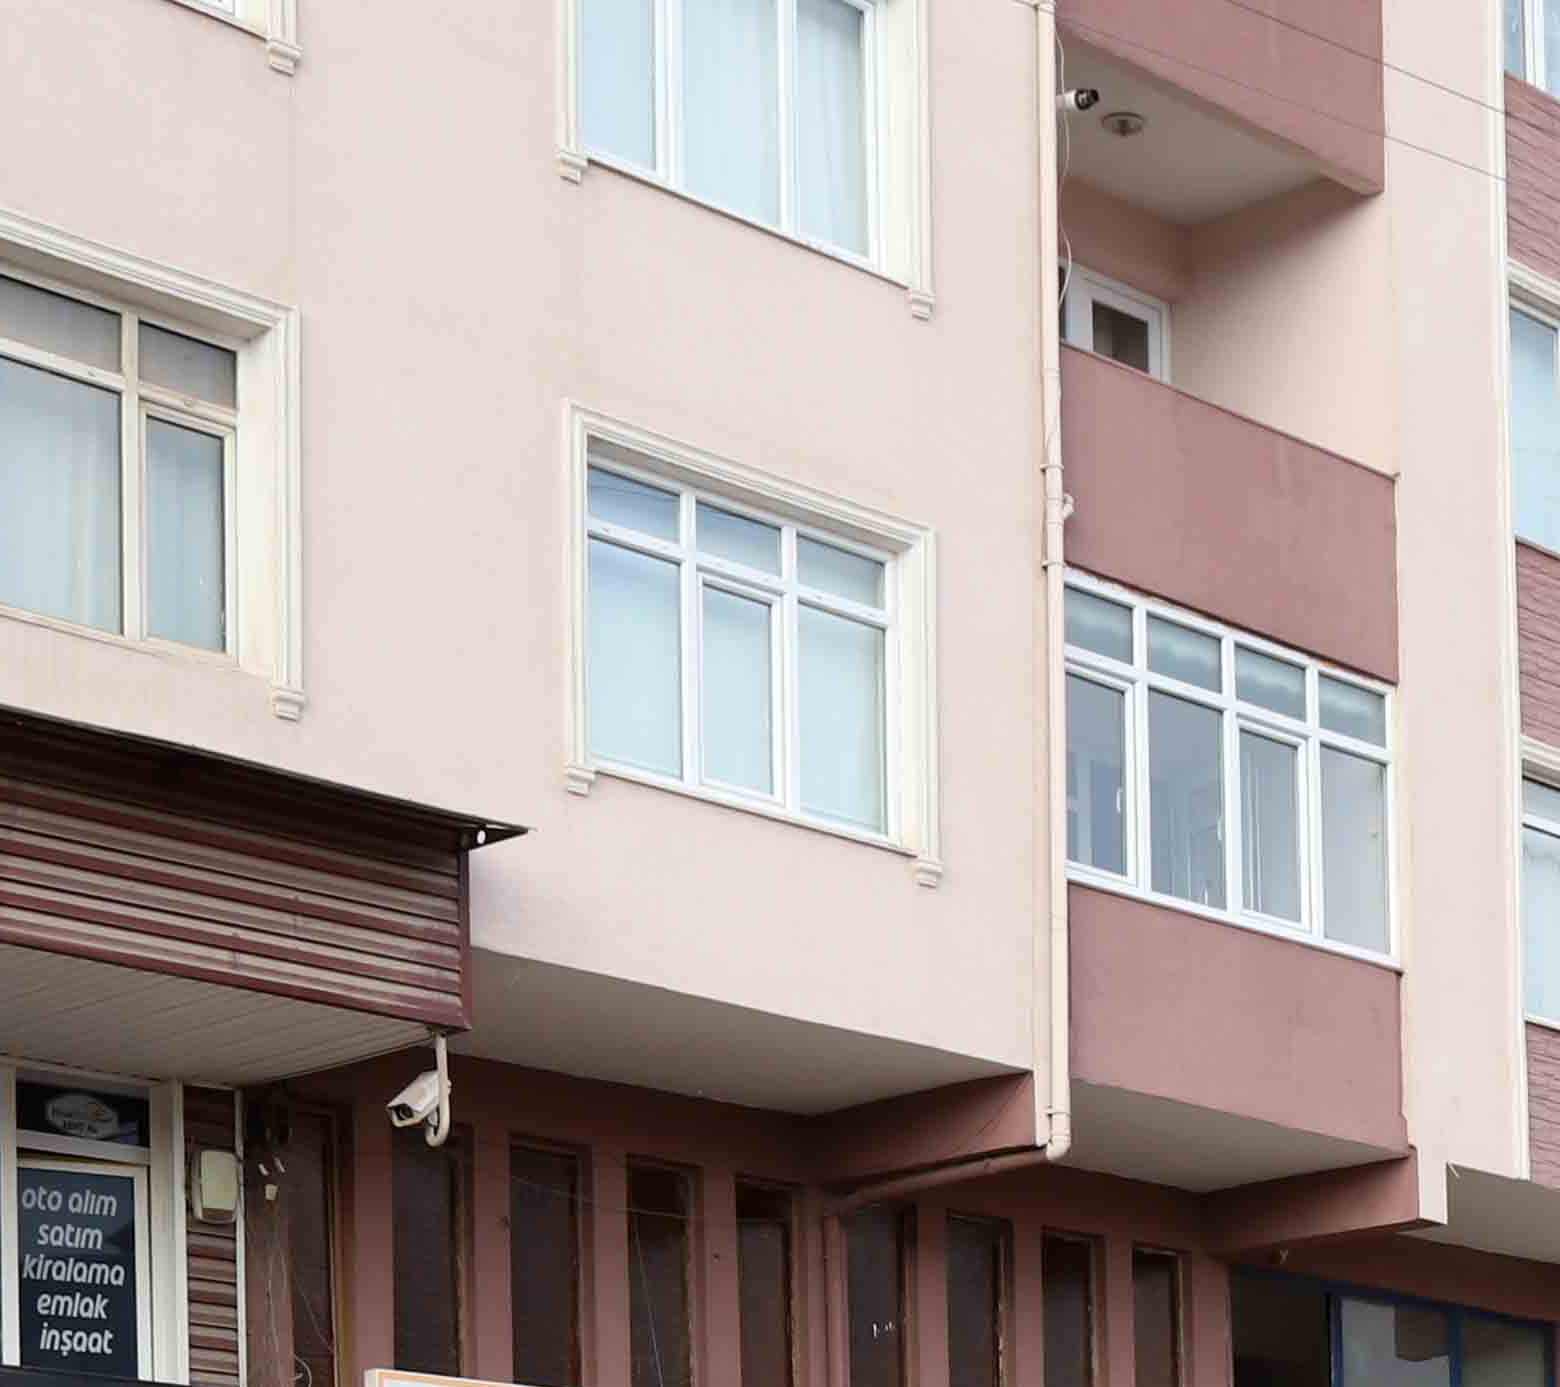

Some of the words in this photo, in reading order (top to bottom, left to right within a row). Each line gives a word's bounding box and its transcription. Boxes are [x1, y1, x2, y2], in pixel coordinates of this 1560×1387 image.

[22, 1186, 63, 1212] oto
[68, 1189, 118, 1217] alım
[37, 1223, 104, 1250] satım
[23, 1253, 126, 1287] kiralama
[36, 1291, 110, 1319] emlak
[39, 1322, 114, 1358] inşaat
